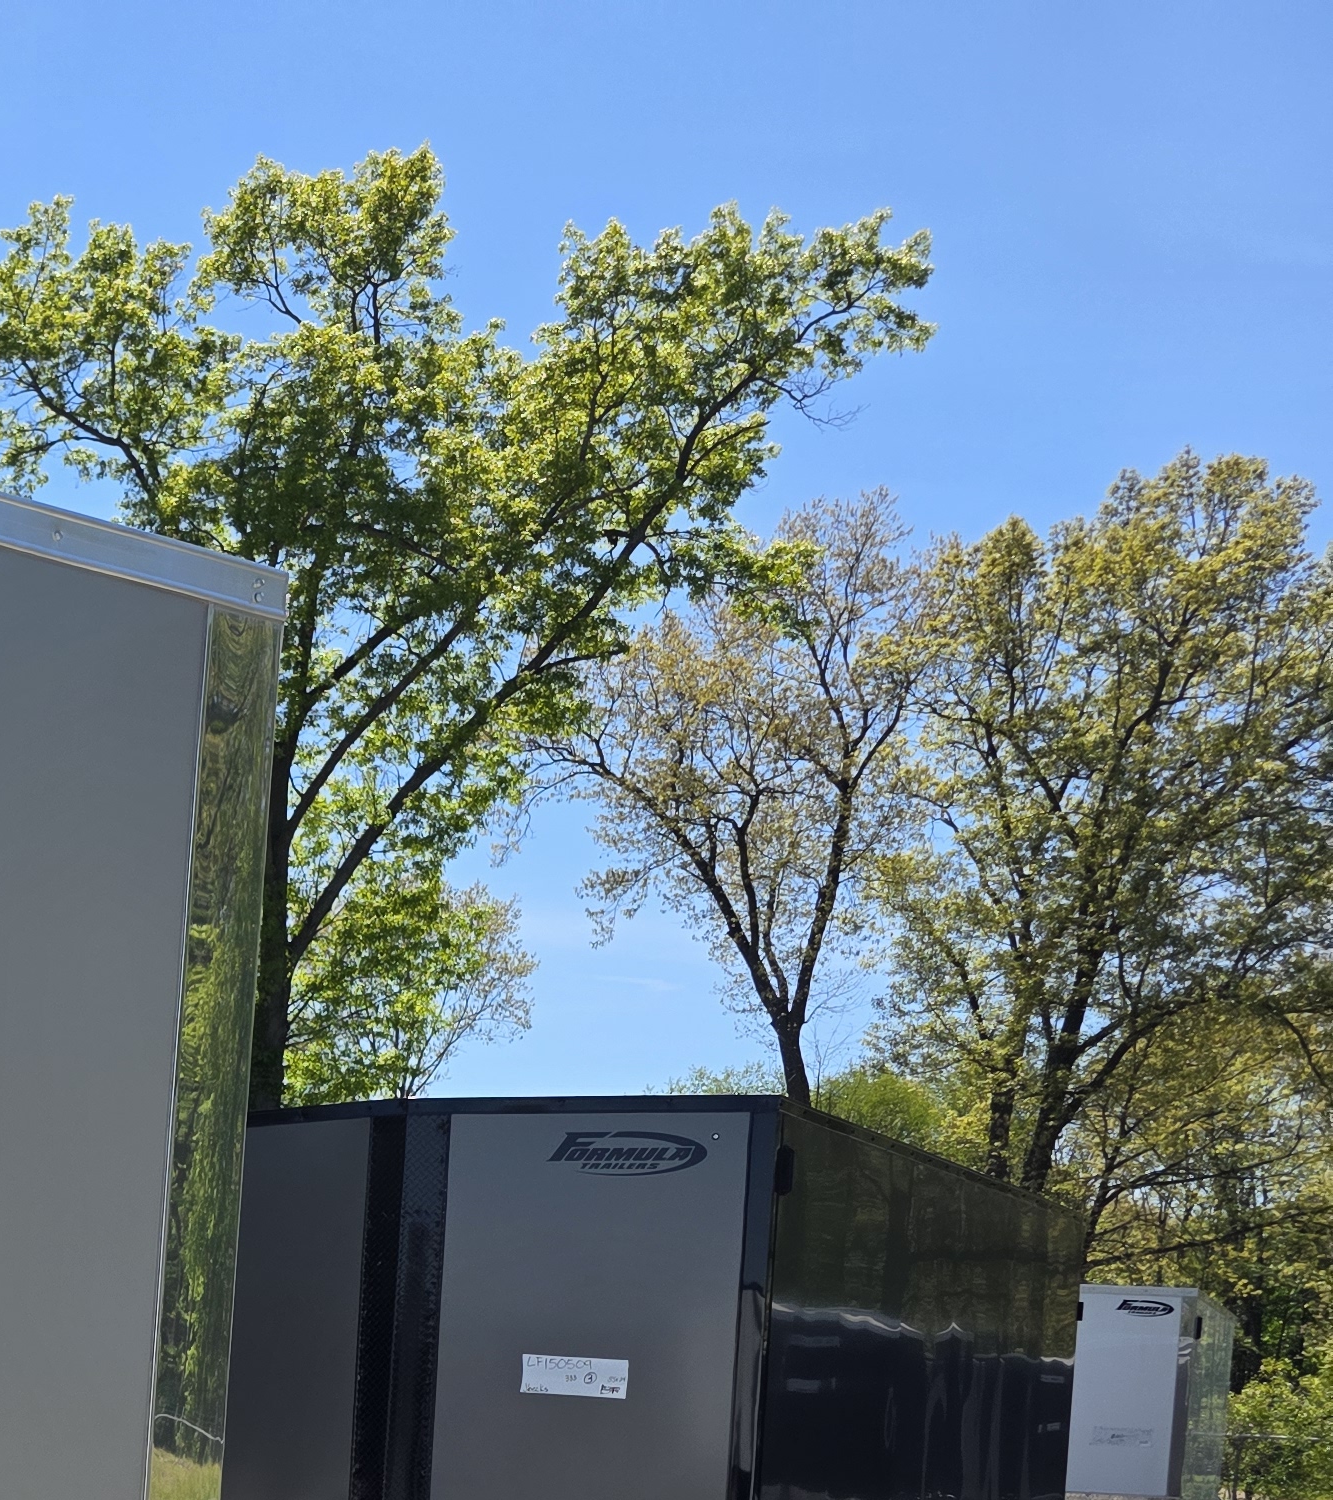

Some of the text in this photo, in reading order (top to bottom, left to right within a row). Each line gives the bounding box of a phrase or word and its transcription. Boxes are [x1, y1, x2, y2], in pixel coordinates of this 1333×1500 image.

[546, 1131, 694, 1162] FORMULA
[580, 1162, 660, 1170] TRAILERS
[527, 1356, 592, 1370] LF150509
